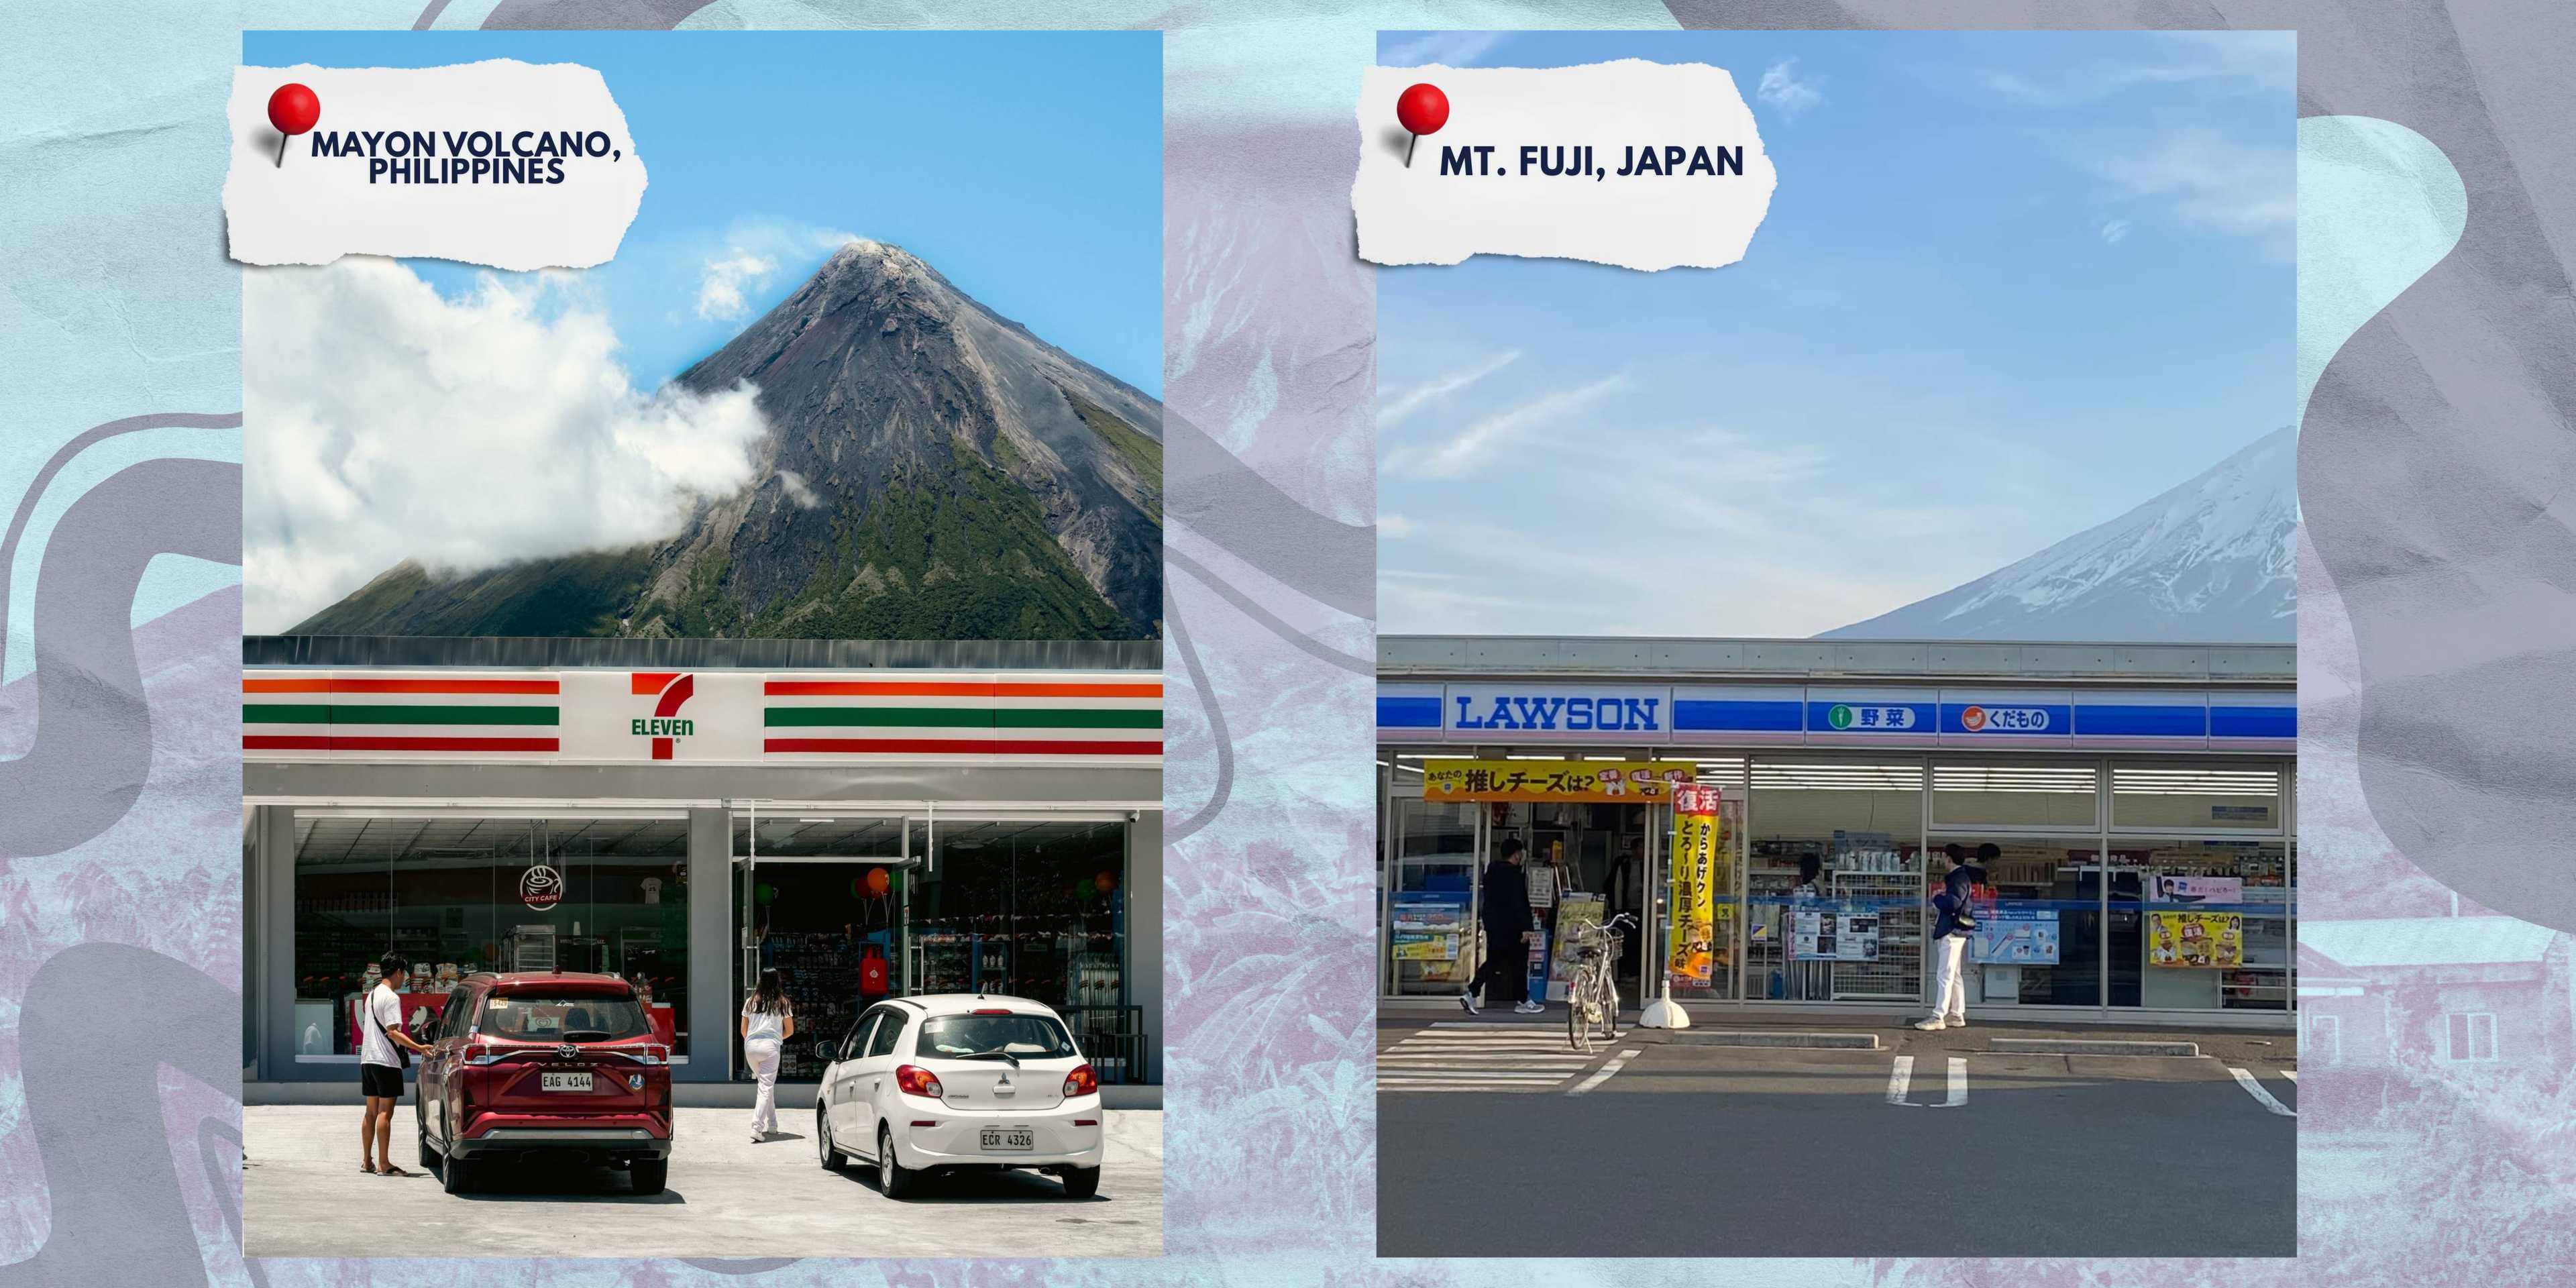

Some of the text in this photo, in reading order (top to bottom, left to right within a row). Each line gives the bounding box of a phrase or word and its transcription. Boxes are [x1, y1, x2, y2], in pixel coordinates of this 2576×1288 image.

[1455, 696, 1659, 731] LAWSON
[1860, 708, 1905, 727] 野菜
[1989, 710, 2045, 729] くだもの
[1428, 769, 1462, 782] あなたの
[1677, 790, 1719, 812] 復活
[543, 1076, 591, 1087] EAG 4144
[982, 1134, 1032, 1146] ECR 4326
